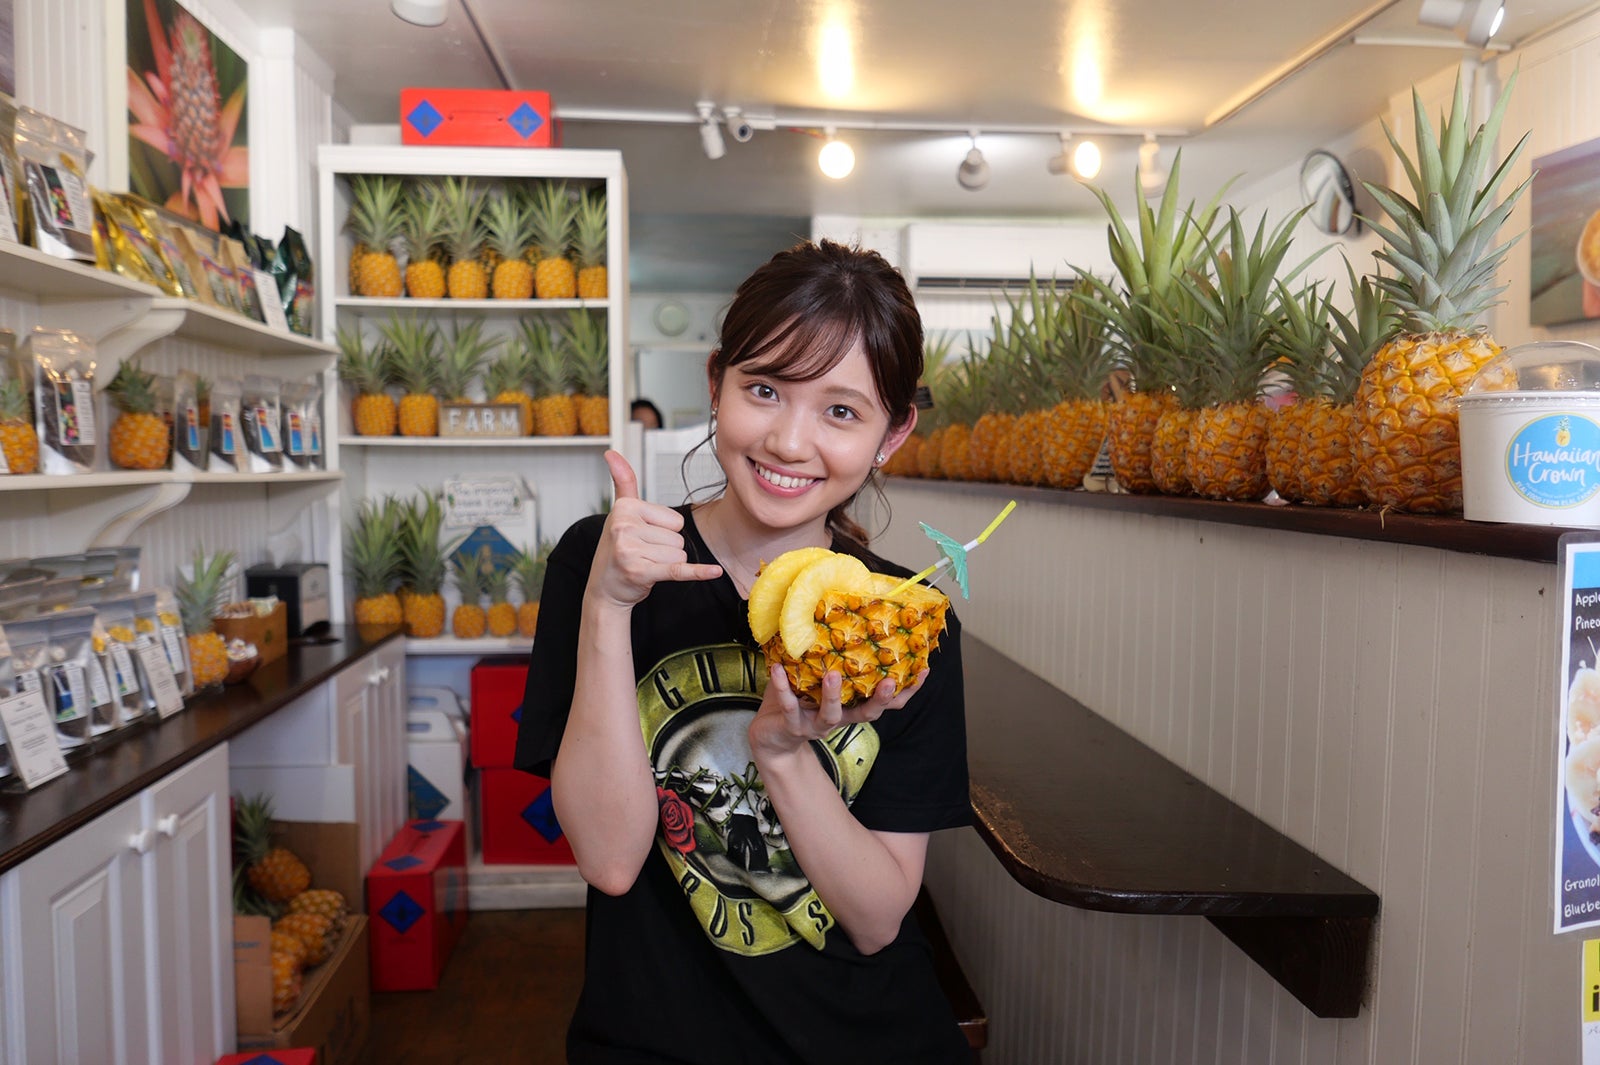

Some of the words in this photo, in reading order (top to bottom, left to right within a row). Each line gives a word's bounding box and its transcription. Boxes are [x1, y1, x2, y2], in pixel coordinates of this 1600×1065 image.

[448, 407, 519, 432] FARM
[1514, 442, 1600, 472] Hawaiian
[1528, 461, 1587, 488] Crown
[653, 649, 757, 711] GUN
[1564, 874, 1600, 892] Granol
